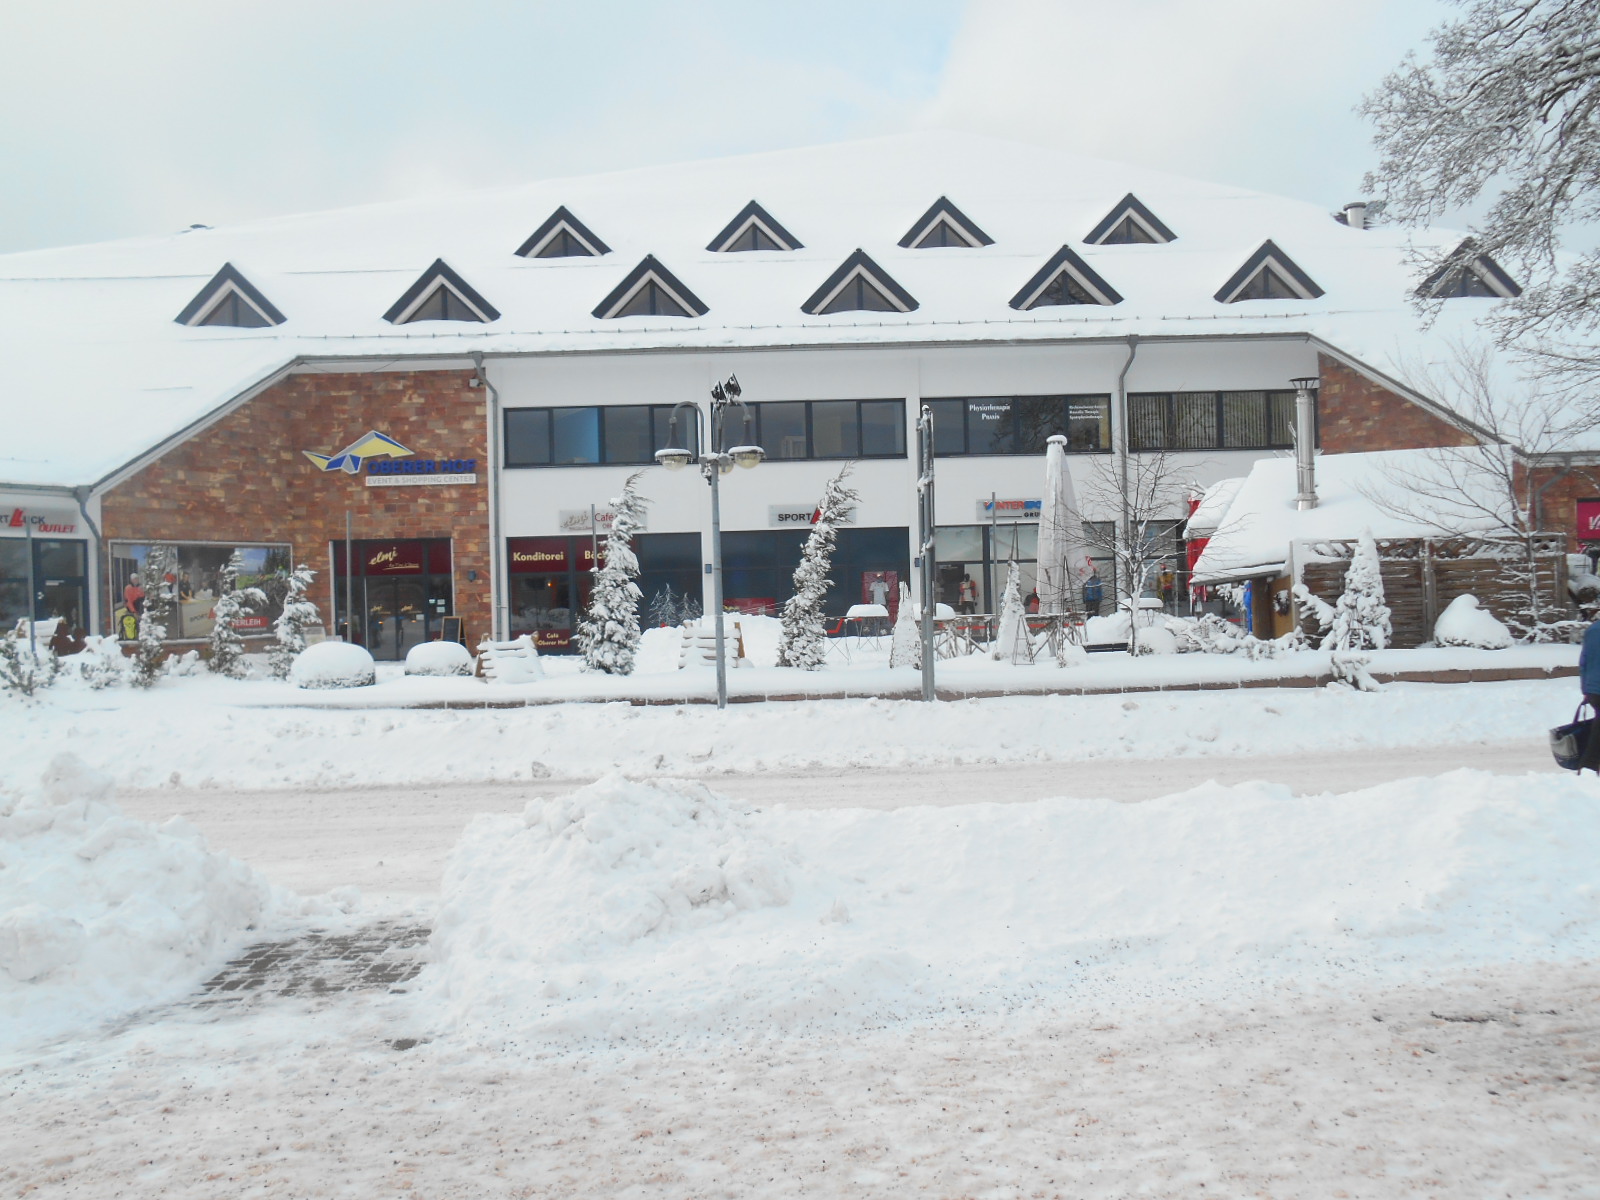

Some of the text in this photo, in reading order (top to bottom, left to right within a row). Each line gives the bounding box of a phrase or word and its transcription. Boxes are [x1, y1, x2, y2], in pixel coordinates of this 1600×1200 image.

[367, 458, 476, 474] OBERER HOF
[402, 476, 441, 484] SHOPPING
[443, 475, 474, 483] CENTER
[778, 513, 812, 522] SPORT
[39, 524, 76, 533] OUTLET
[513, 551, 564, 561] Konditorei
